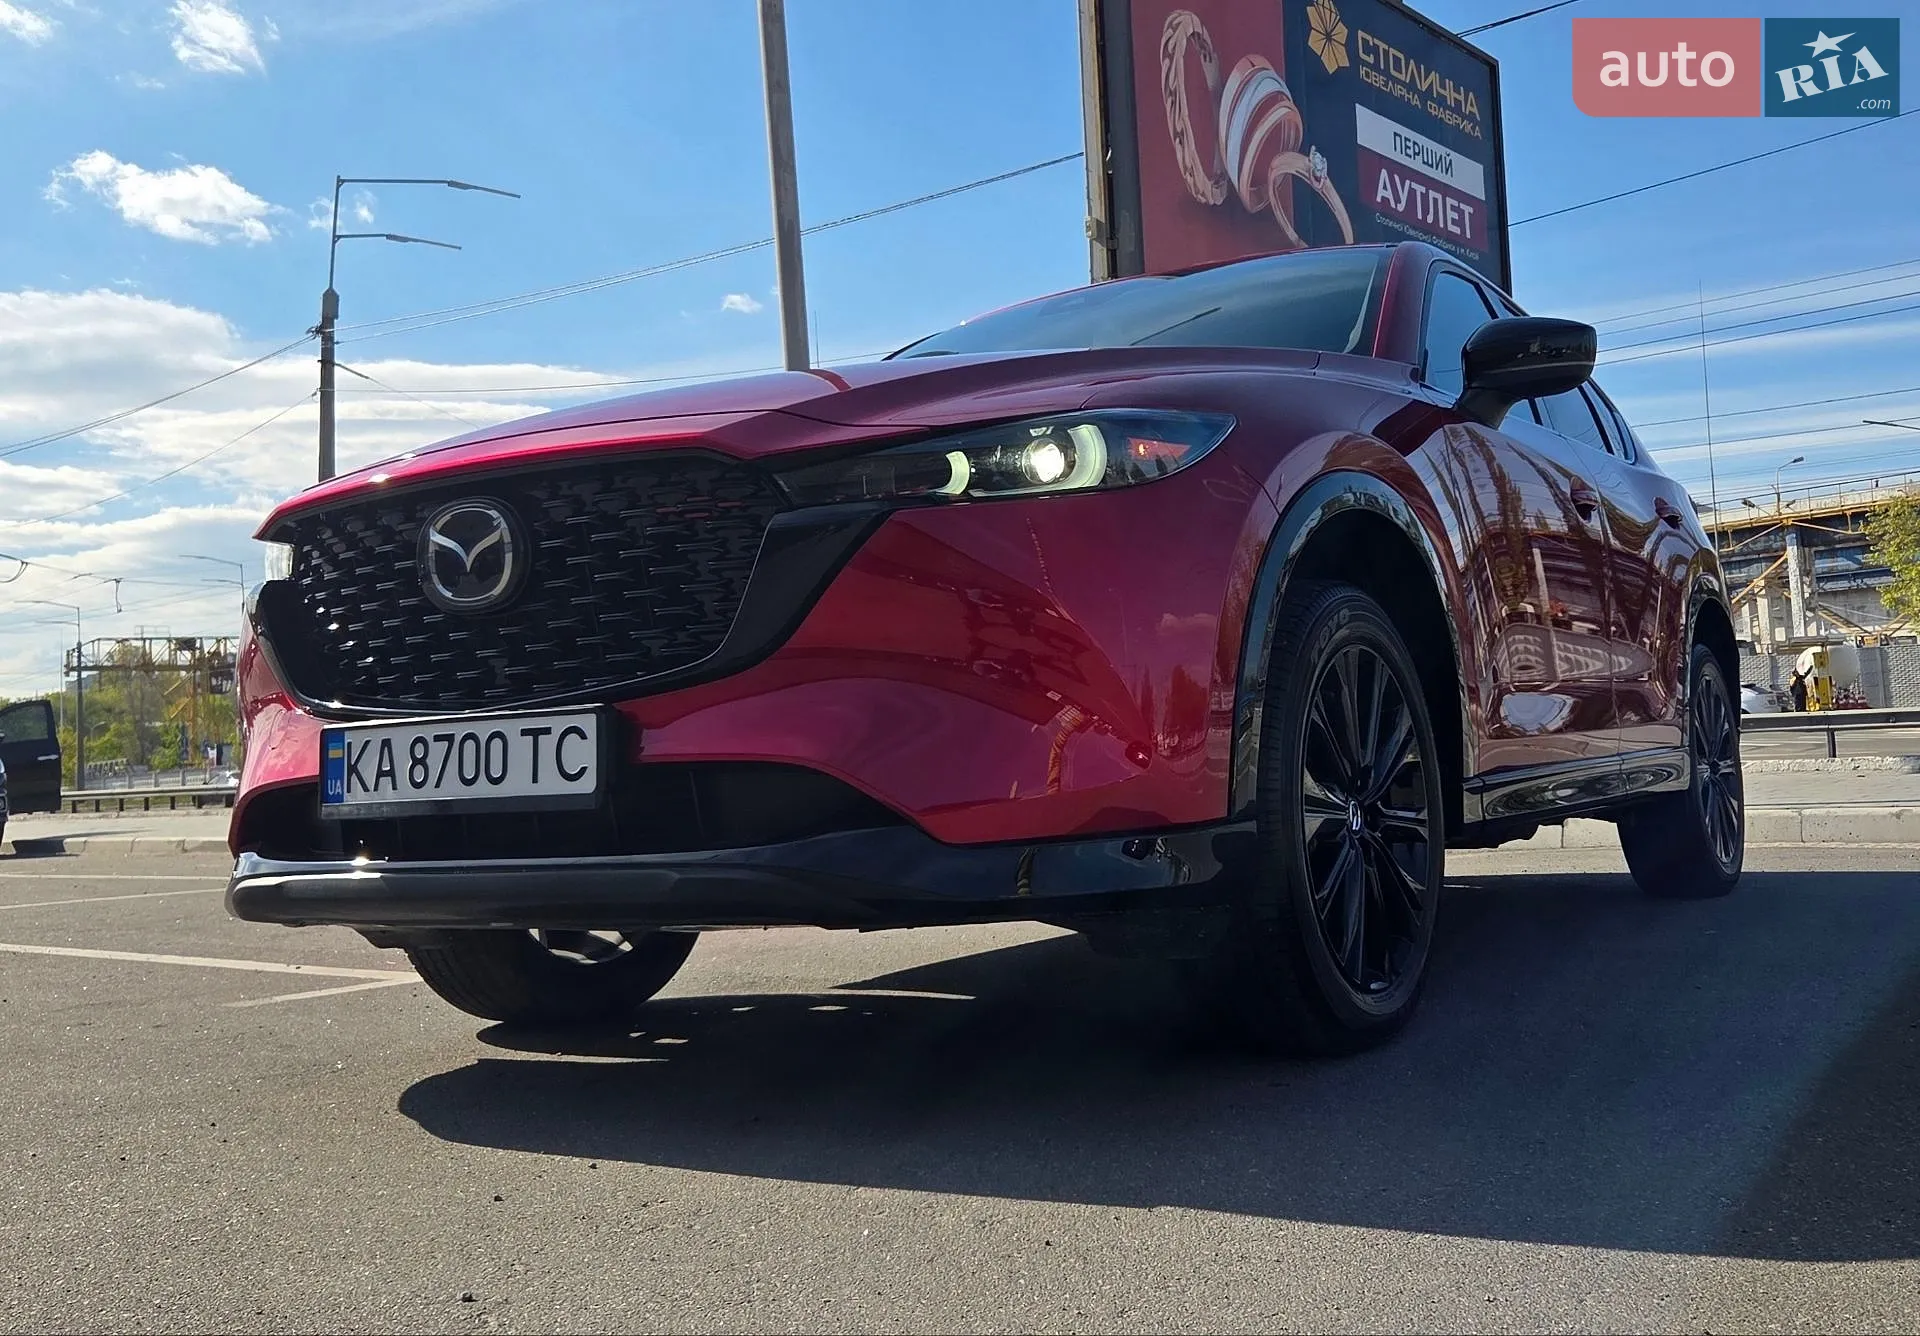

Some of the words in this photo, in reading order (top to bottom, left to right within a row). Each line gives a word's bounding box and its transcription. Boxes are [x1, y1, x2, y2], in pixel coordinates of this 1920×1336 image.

[1358, 30, 1480, 120] СТОЛИЧНА
[1360, 65, 1421, 109] ЮВЕЛІРНА
[1427, 100, 1480, 140] ФАБРИКА
[1393, 131, 1454, 178] ПЕРШИЙ
[1376, 168, 1474, 239] АУТЛЕТ
[328, 779, 342, 795] UA
[347, 738, 397, 793] KA
[408, 732, 508, 789] 8700
[520, 725, 589, 784] TC
